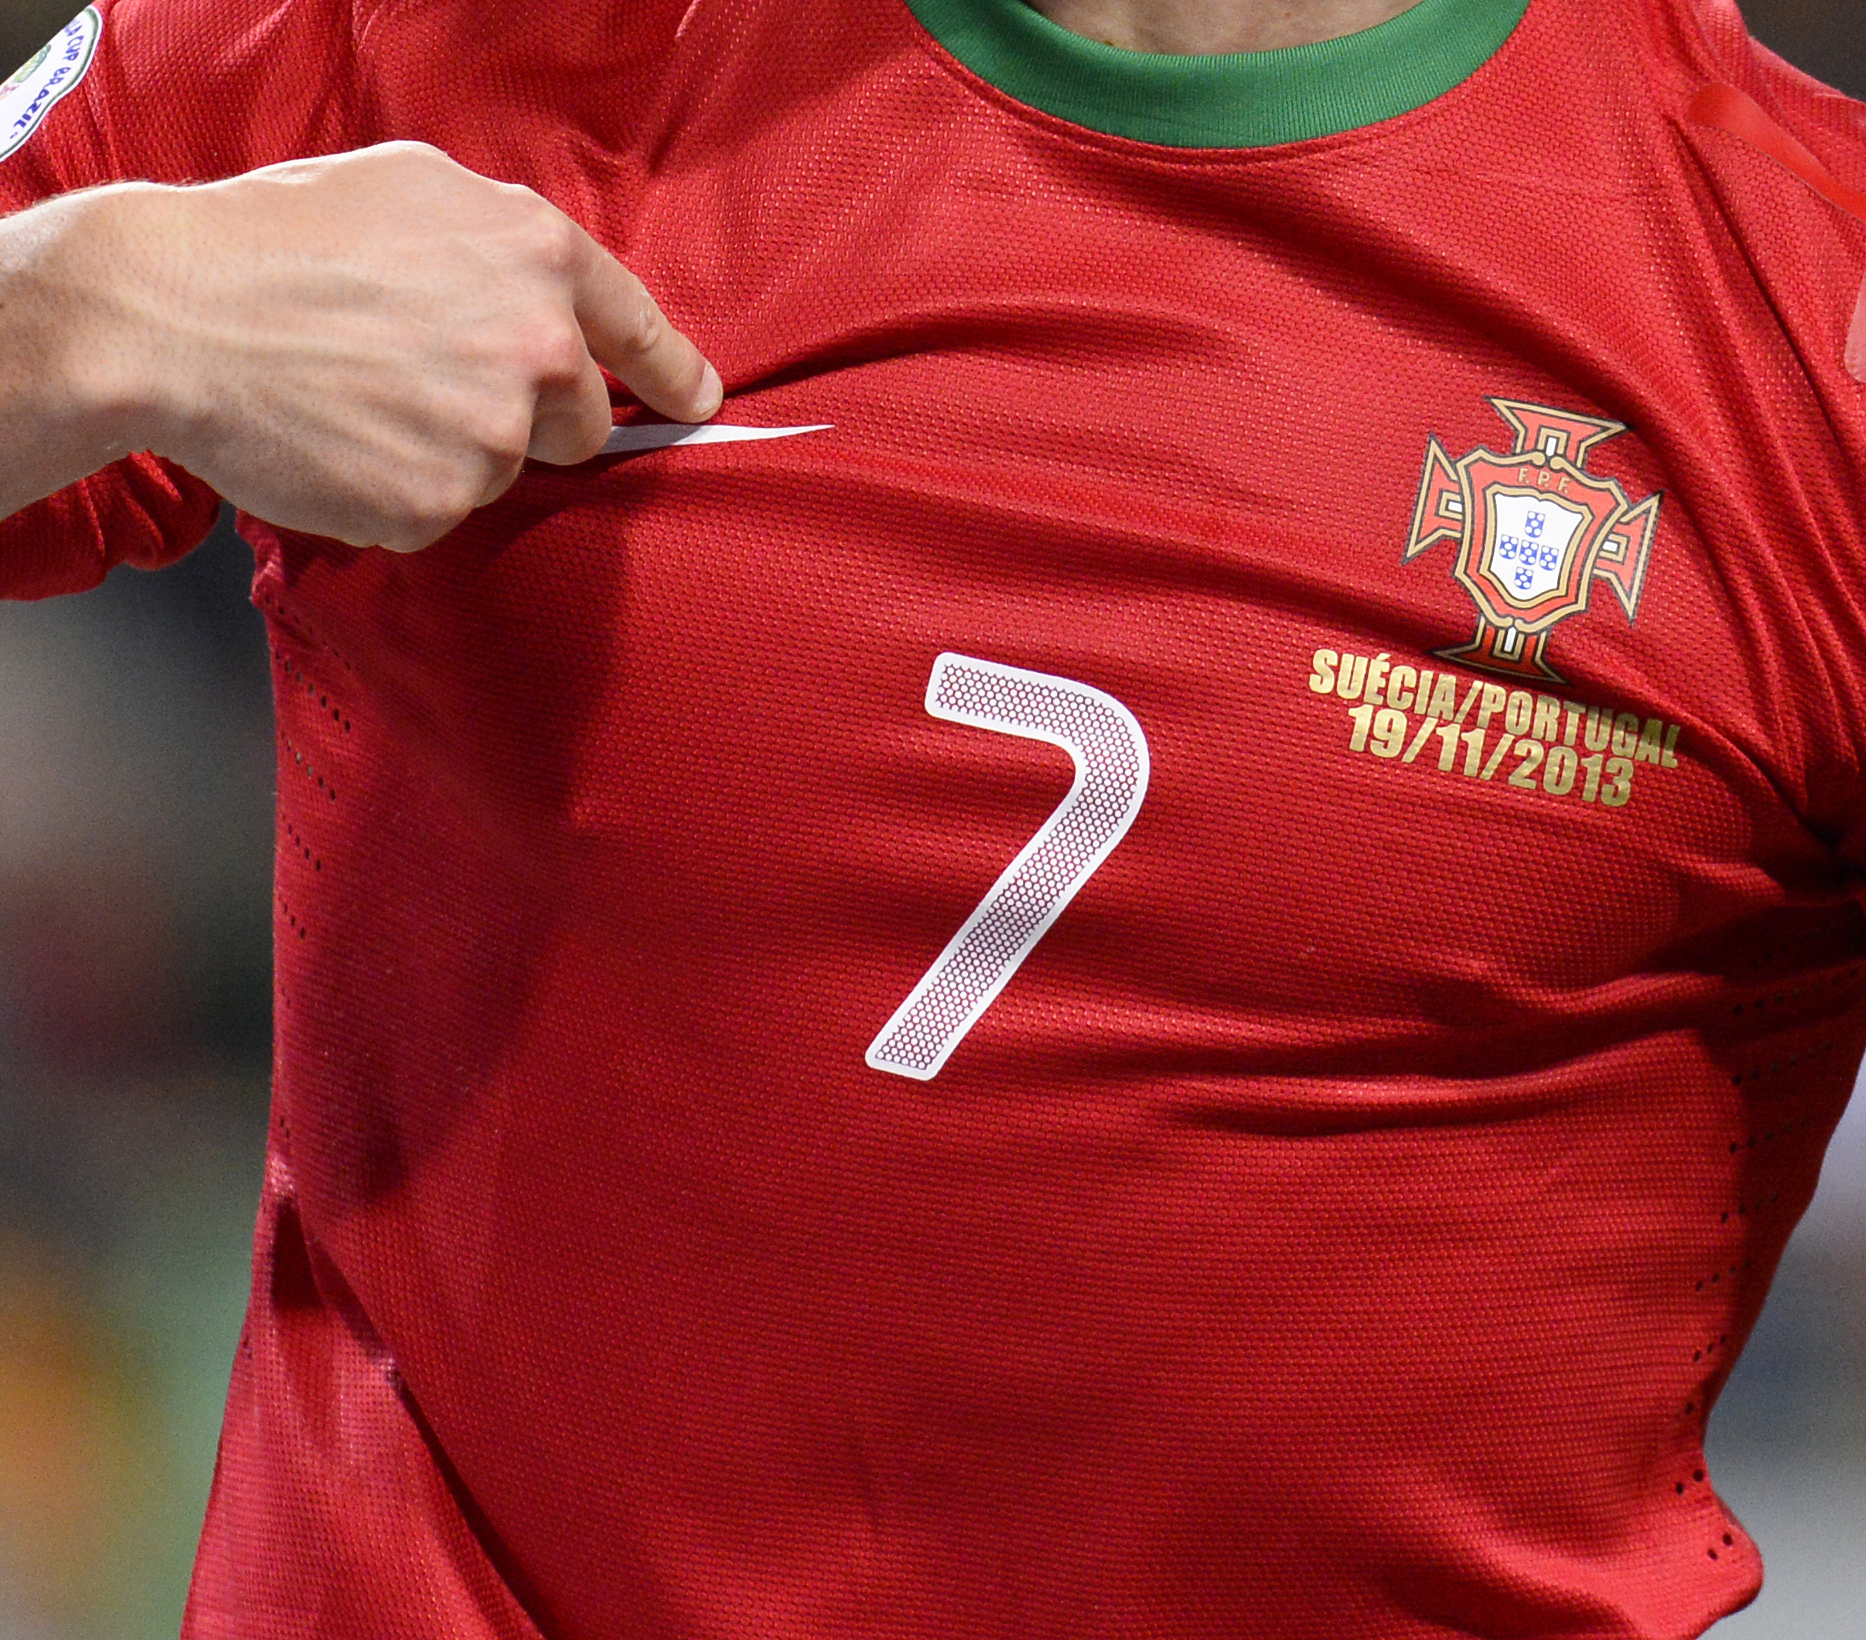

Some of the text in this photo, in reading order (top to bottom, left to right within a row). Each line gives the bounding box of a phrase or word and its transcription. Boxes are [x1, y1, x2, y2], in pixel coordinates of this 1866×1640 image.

[63, 35, 84, 61] CUP
[1308, 648, 1681, 769] SUÉCIA/PORTUGAL
[1348, 703, 1634, 807] 19/11/2013
[865, 651, 1151, 1080] 7
